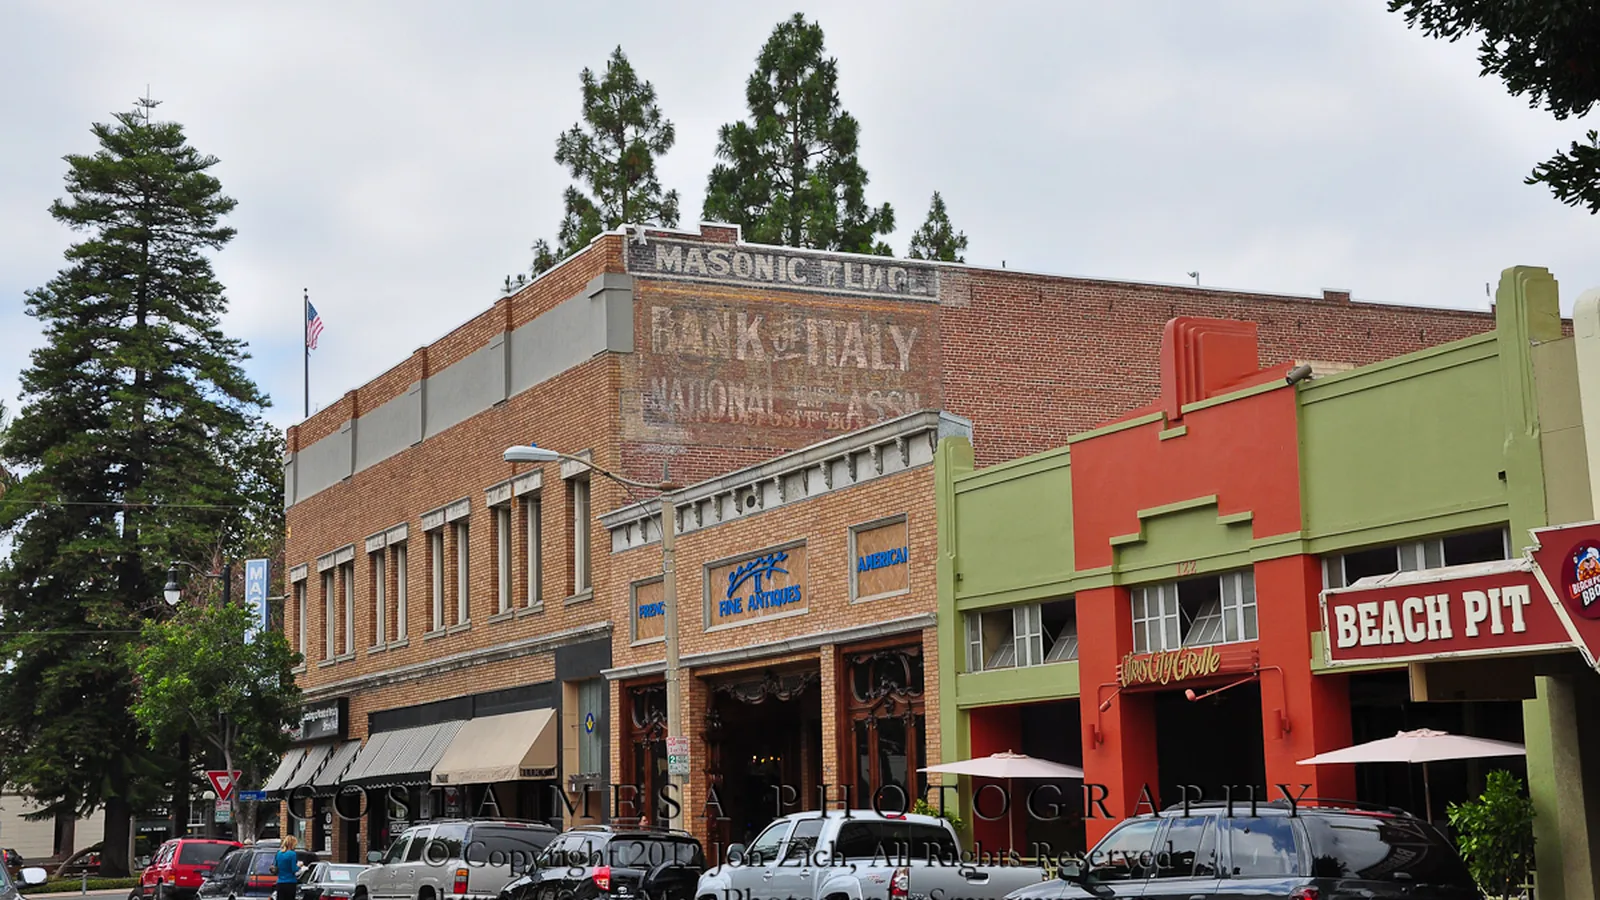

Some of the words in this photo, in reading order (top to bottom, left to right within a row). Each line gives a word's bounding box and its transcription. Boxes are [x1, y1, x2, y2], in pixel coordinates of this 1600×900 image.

[655, 244, 808, 284] MASONIC
[803, 318, 919, 372] ITALY
[1176, 560, 1197, 577] 122
[639, 600, 665, 619] FRENC
[719, 597, 743, 617] FINE
[747, 584, 802, 611] ANTIQUES
[1334, 593, 1453, 648] BEACH
[1462, 584, 1531, 637] PIT
